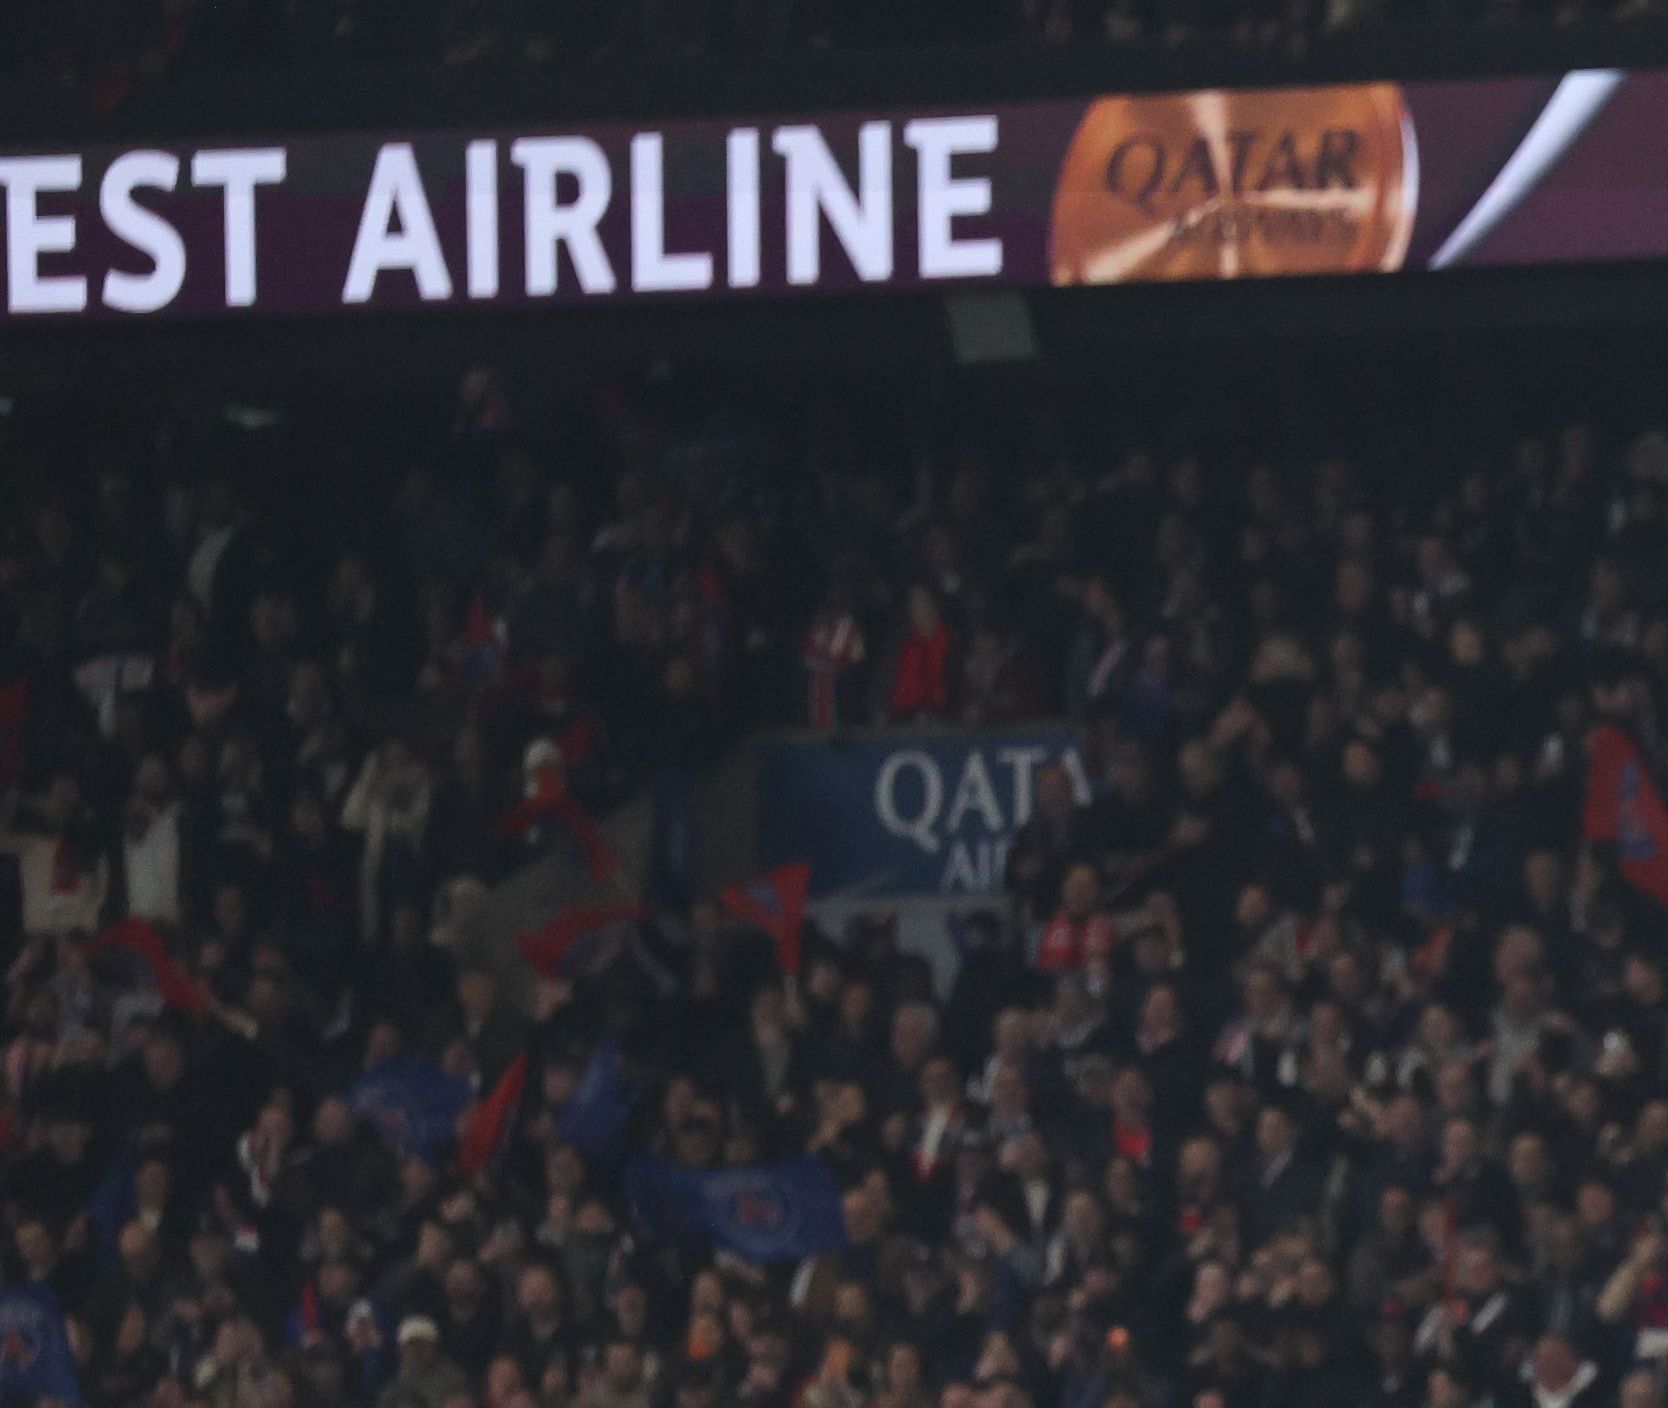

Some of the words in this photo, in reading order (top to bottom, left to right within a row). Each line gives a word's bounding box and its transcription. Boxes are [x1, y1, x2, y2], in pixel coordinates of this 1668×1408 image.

[0, 148, 287, 313] EST
[342, 116, 1003, 303] AIRLINE
[874, 747, 1093, 853] QAT
